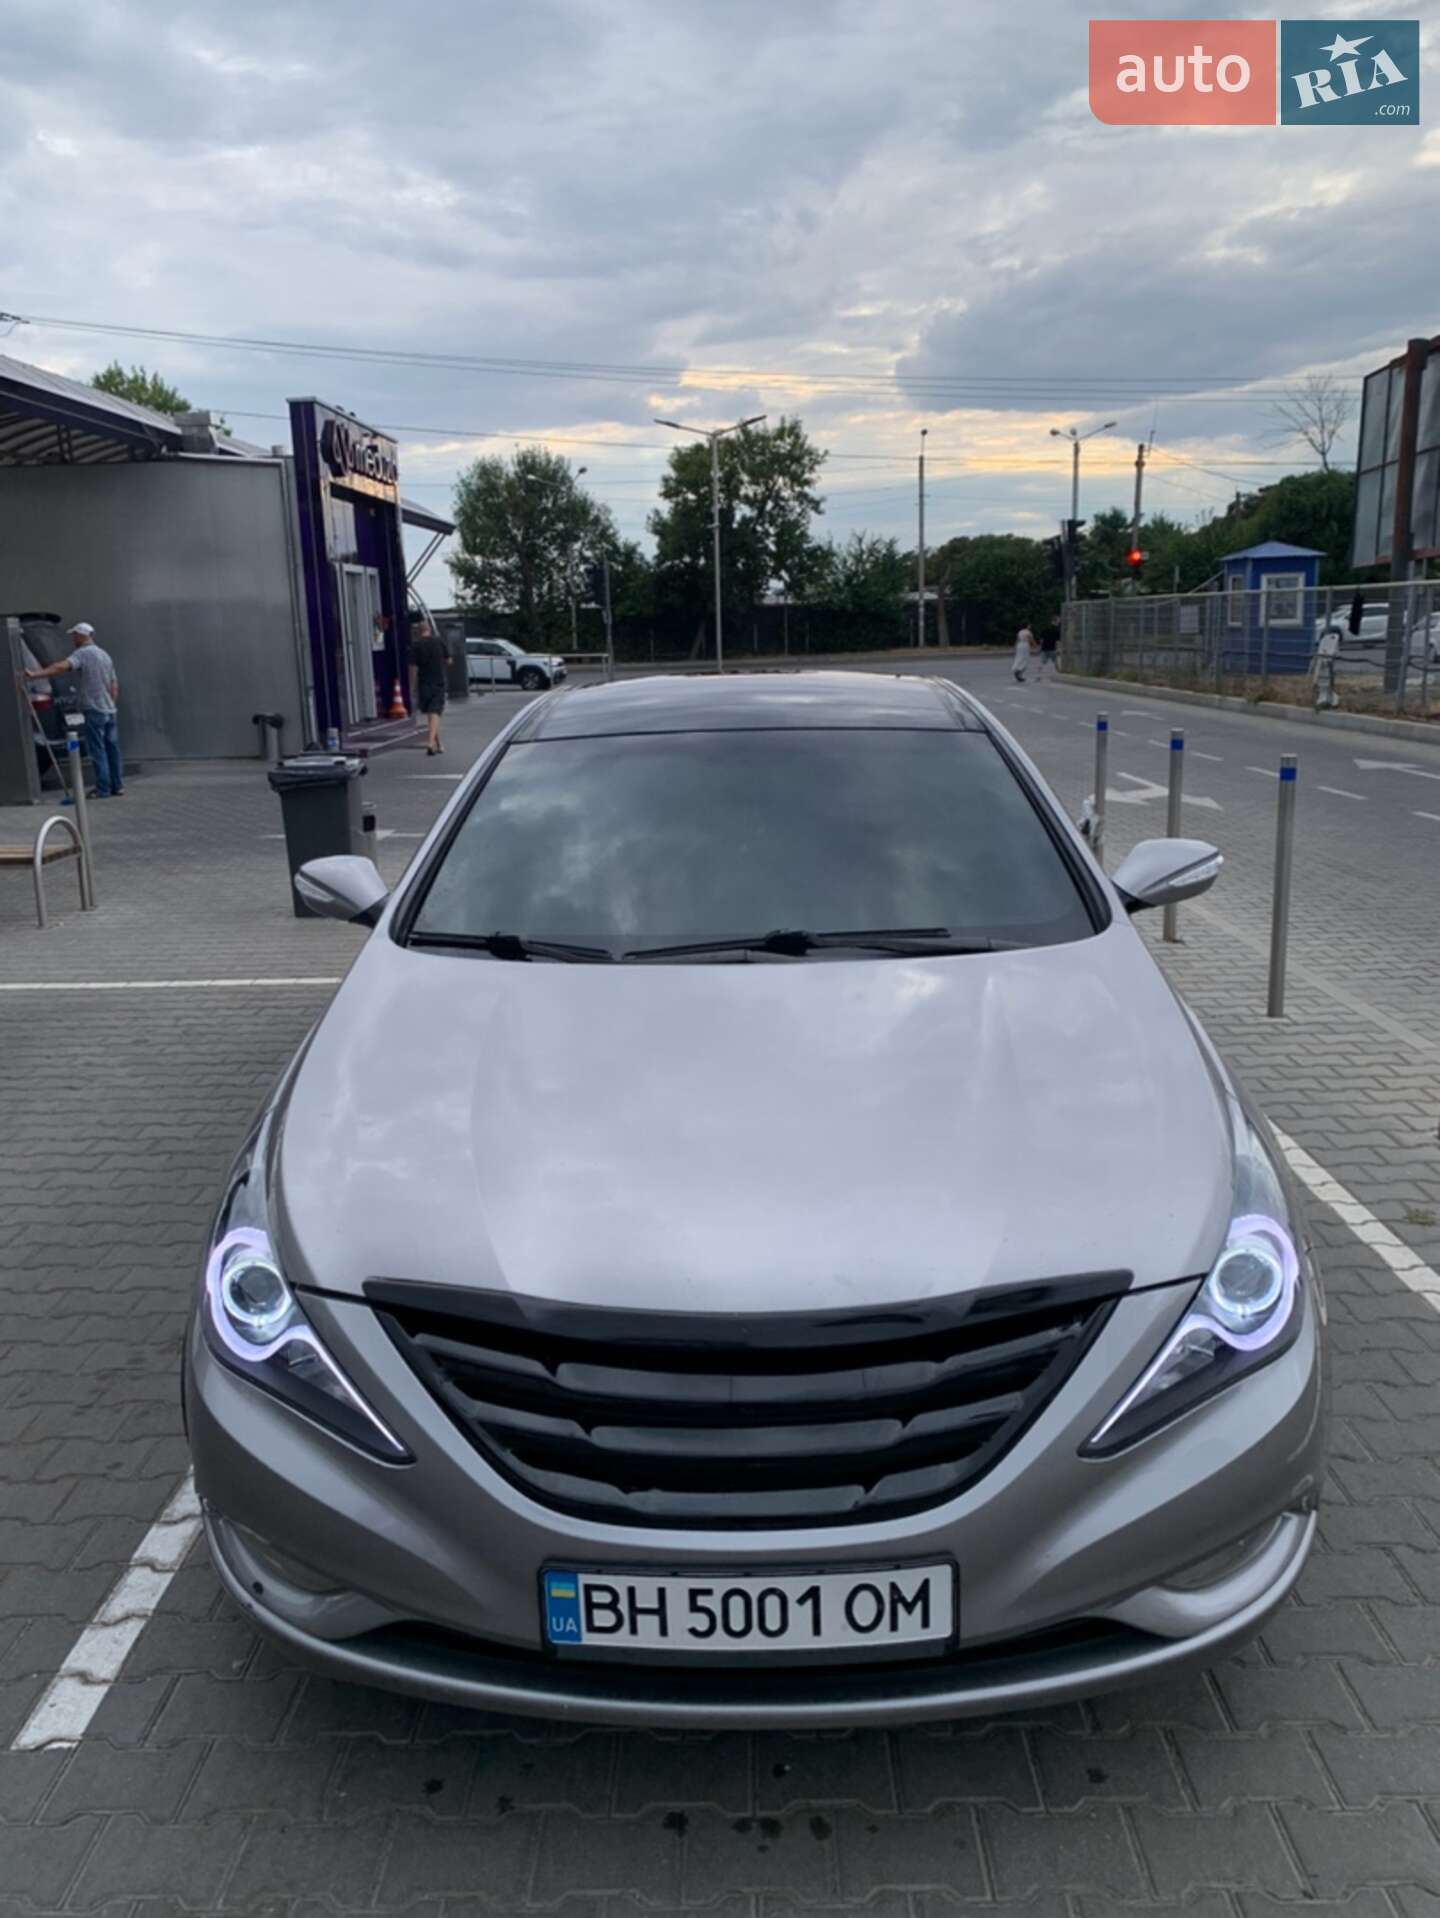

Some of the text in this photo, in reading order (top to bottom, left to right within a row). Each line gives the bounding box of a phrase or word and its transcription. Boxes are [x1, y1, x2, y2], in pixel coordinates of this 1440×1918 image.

[551, 1577, 931, 1639] UA BH 5001 OM
